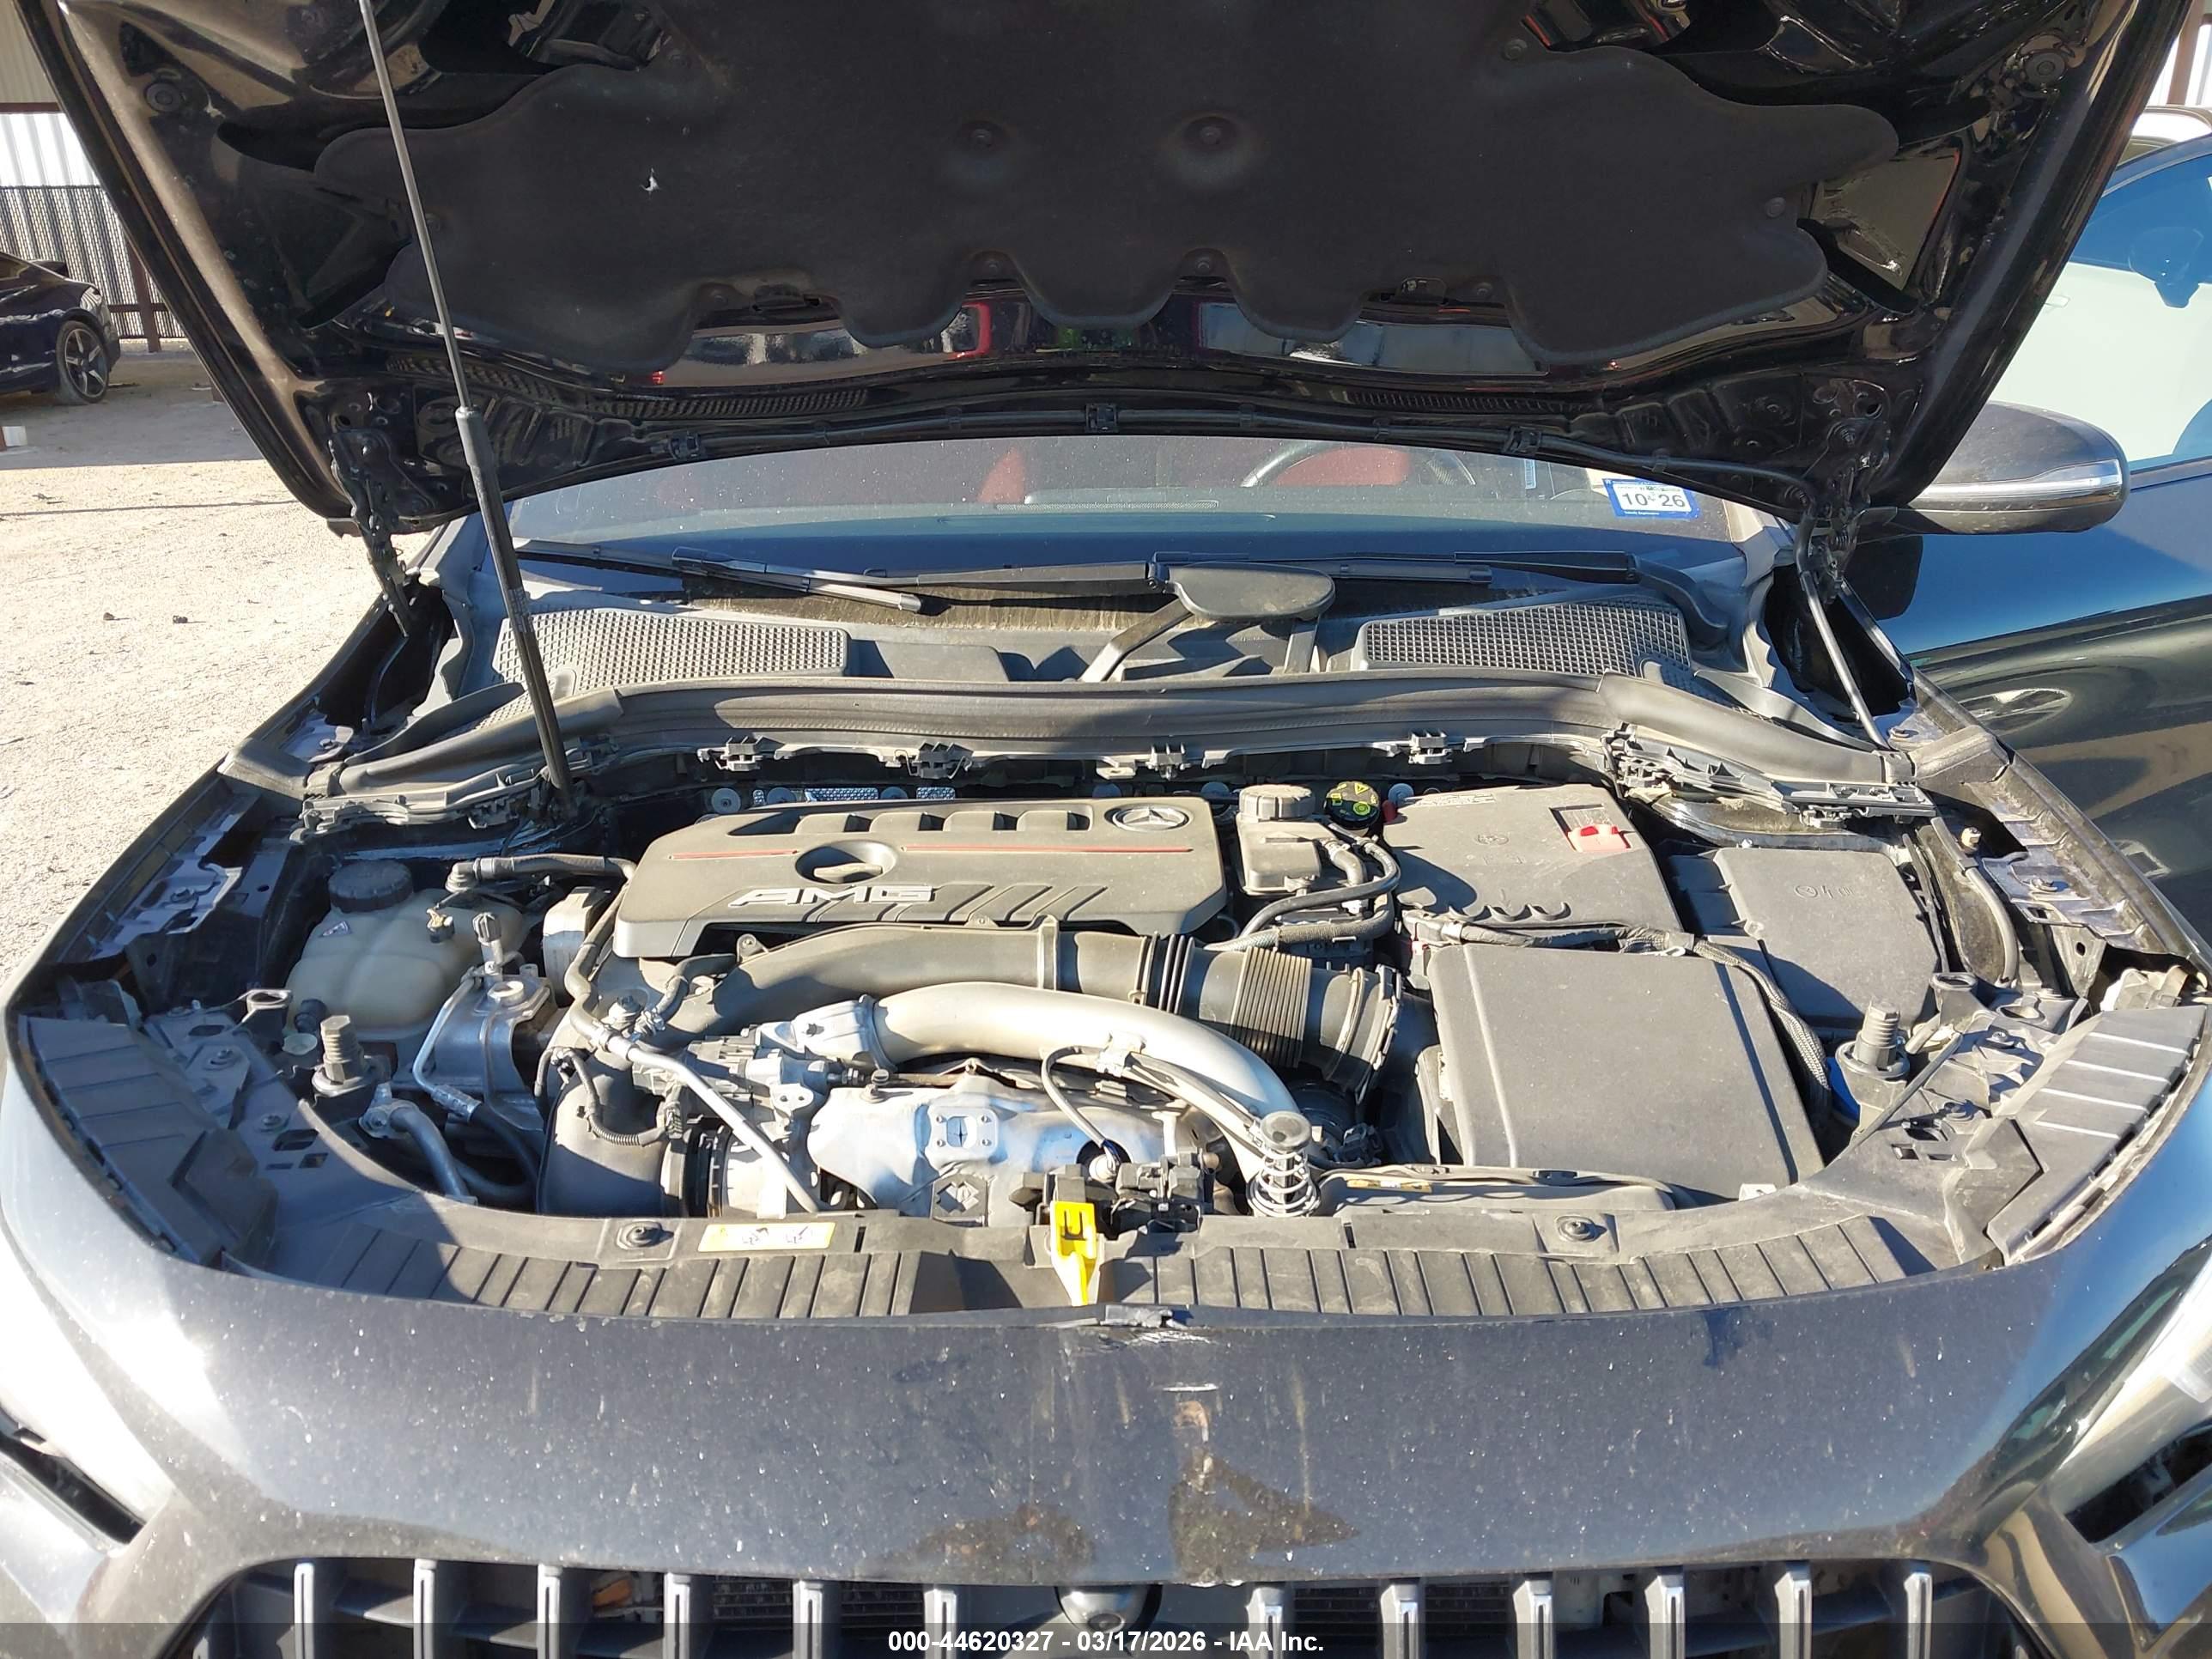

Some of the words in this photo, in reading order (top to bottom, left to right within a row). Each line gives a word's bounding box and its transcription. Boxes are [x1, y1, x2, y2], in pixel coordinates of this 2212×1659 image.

[1622, 493, 1648, 506] 10
[1658, 494, 1686, 507] 26
[728, 885, 938, 907] AMG
